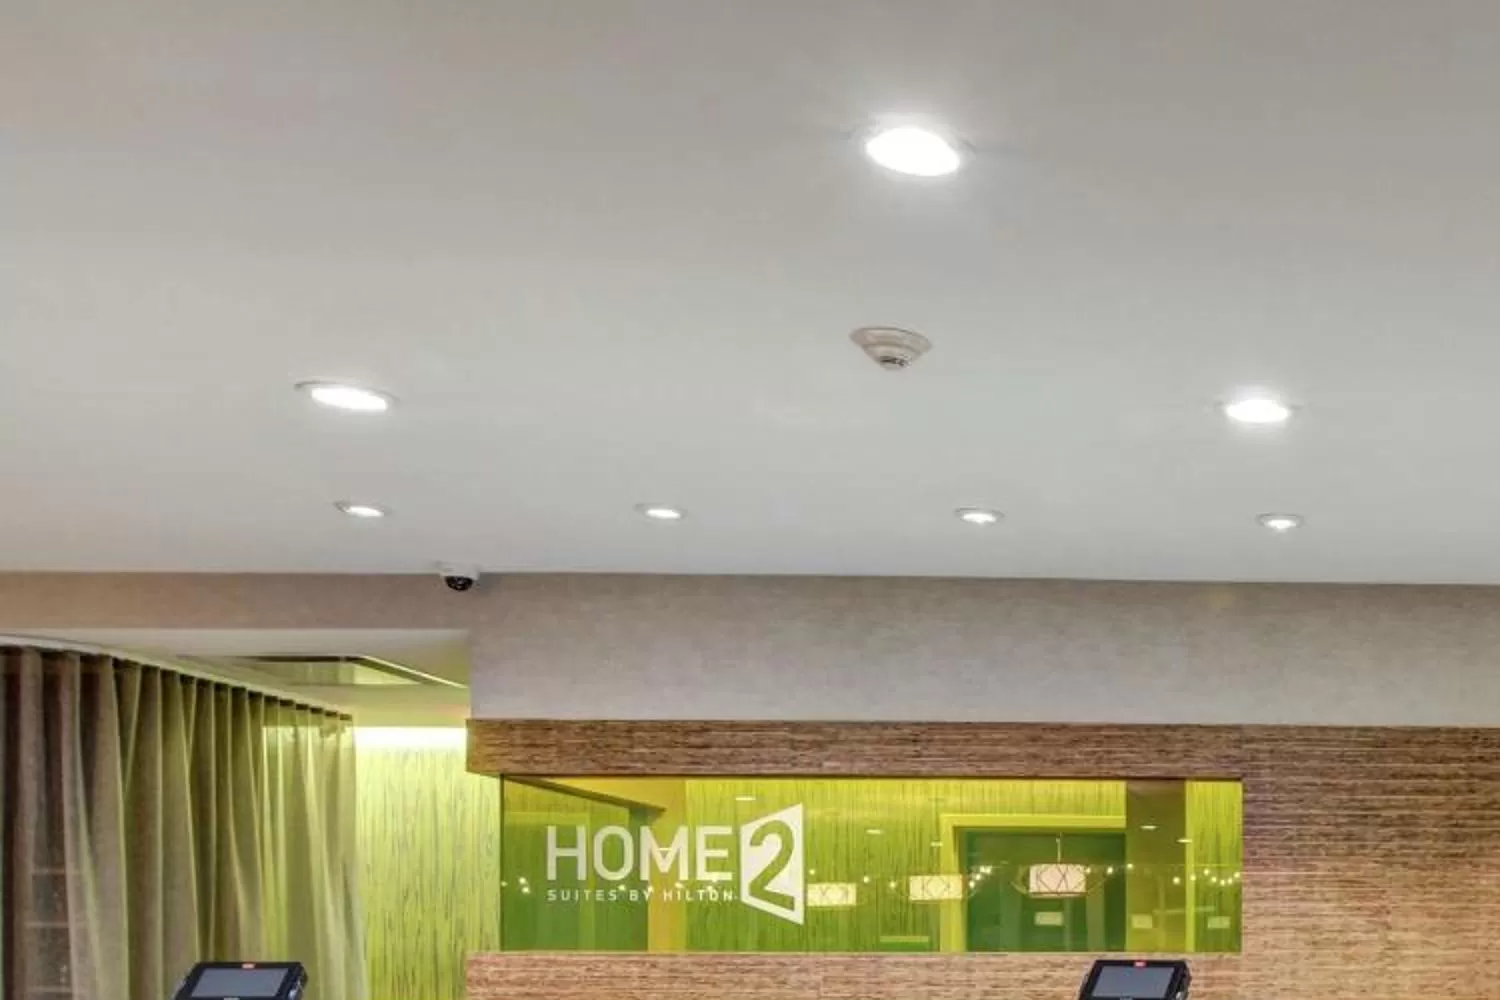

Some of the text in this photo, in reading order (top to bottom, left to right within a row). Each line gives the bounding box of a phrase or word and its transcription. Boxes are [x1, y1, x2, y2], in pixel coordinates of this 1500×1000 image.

[547, 889, 734, 902] SUITES BY HILTON
